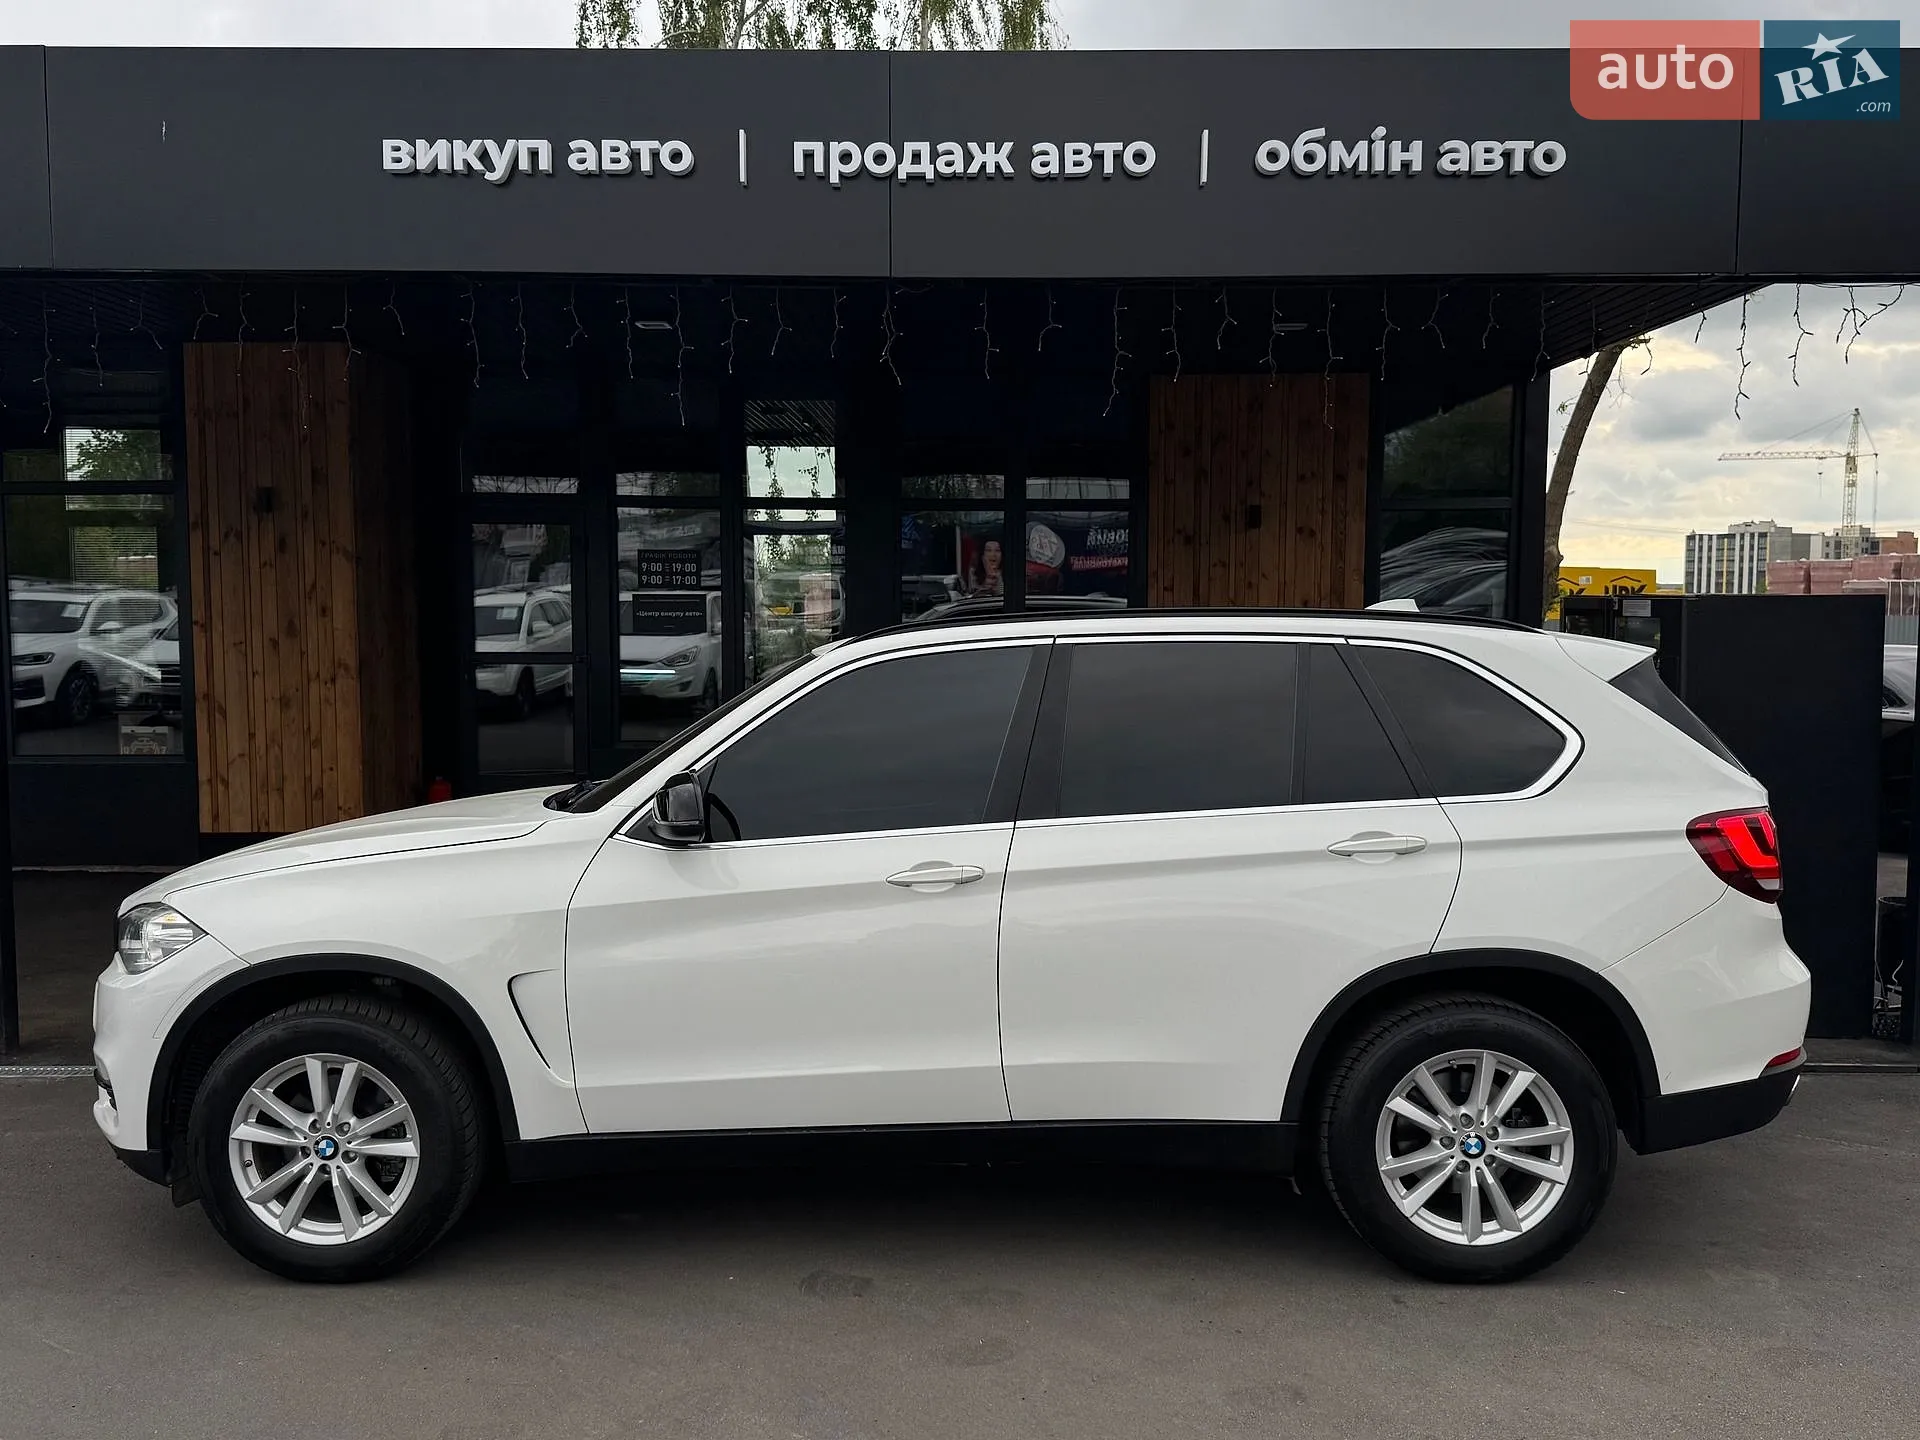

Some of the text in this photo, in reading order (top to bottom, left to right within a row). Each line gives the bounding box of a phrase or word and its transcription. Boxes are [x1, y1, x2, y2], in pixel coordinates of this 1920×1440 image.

[382, 139, 695, 183] викуп авто
[793, 140, 1157, 187] продаж авто
[1255, 125, 1567, 177] обмін авто
[641, 562, 697, 573] 9:00 19:00
[641, 575, 697, 585] 9:00 17:00
